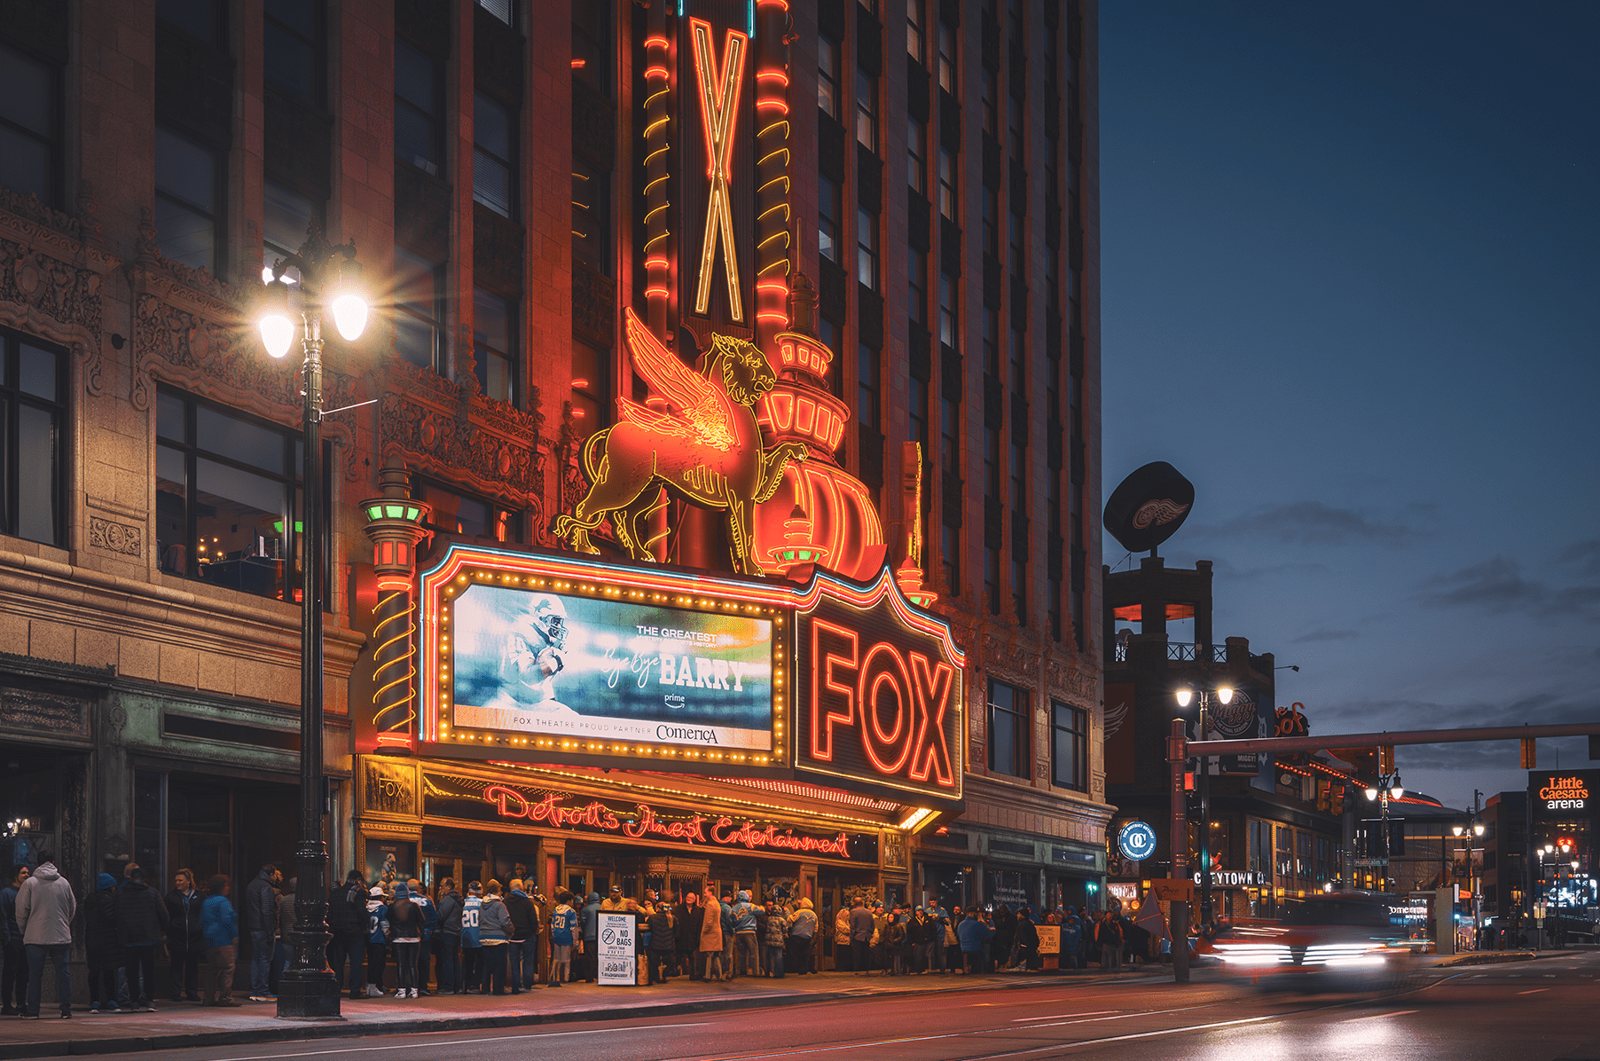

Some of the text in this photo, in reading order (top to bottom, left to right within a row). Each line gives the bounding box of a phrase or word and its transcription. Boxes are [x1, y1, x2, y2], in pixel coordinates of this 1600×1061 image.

[636, 625, 659, 638] THE
[661, 628, 718, 643] GREATEST
[601, 649, 747, 692] Bye Bye BARRY
[664, 693, 685, 704] prime
[811, 617, 955, 787] FOX
[513, 717, 651, 734] FOX THEATRE PROUD PARTNER
[378, 778, 404, 797] FOX
[1549, 776, 1583, 790] Little
[1539, 787, 1589, 800] Caesars
[1547, 799, 1584, 809] arena
[483, 784, 620, 829] Detroit's
[622, 804, 707, 845] Finest
[711, 816, 850, 858] Entertainment
[1129, 833, 1147, 848] OC
[461, 909, 479, 928] 20
[554, 915, 566, 929] 20
[619, 929, 629, 938] NO
[616, 937, 632, 947] BAGS
